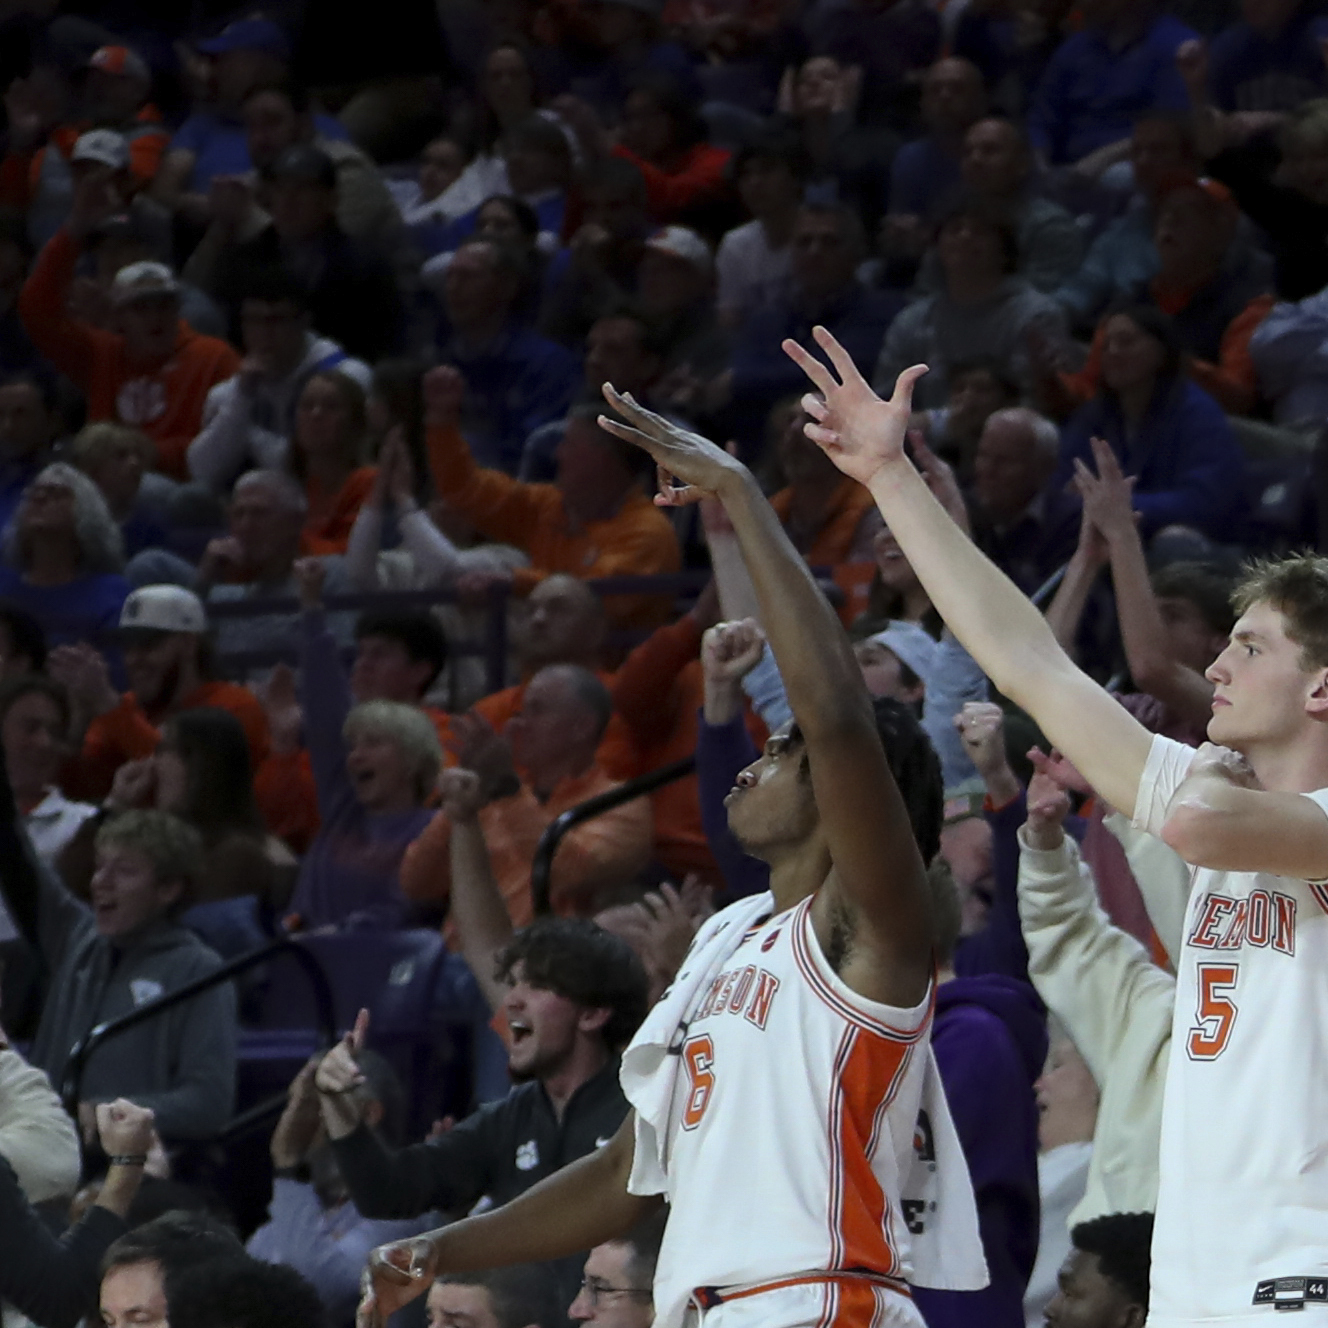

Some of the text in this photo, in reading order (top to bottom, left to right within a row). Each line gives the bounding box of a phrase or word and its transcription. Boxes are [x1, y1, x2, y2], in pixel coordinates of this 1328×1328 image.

[1186, 962, 1239, 1061] 5
[682, 1033, 715, 1131] 6
[1309, 1283, 1325, 1295] 44
